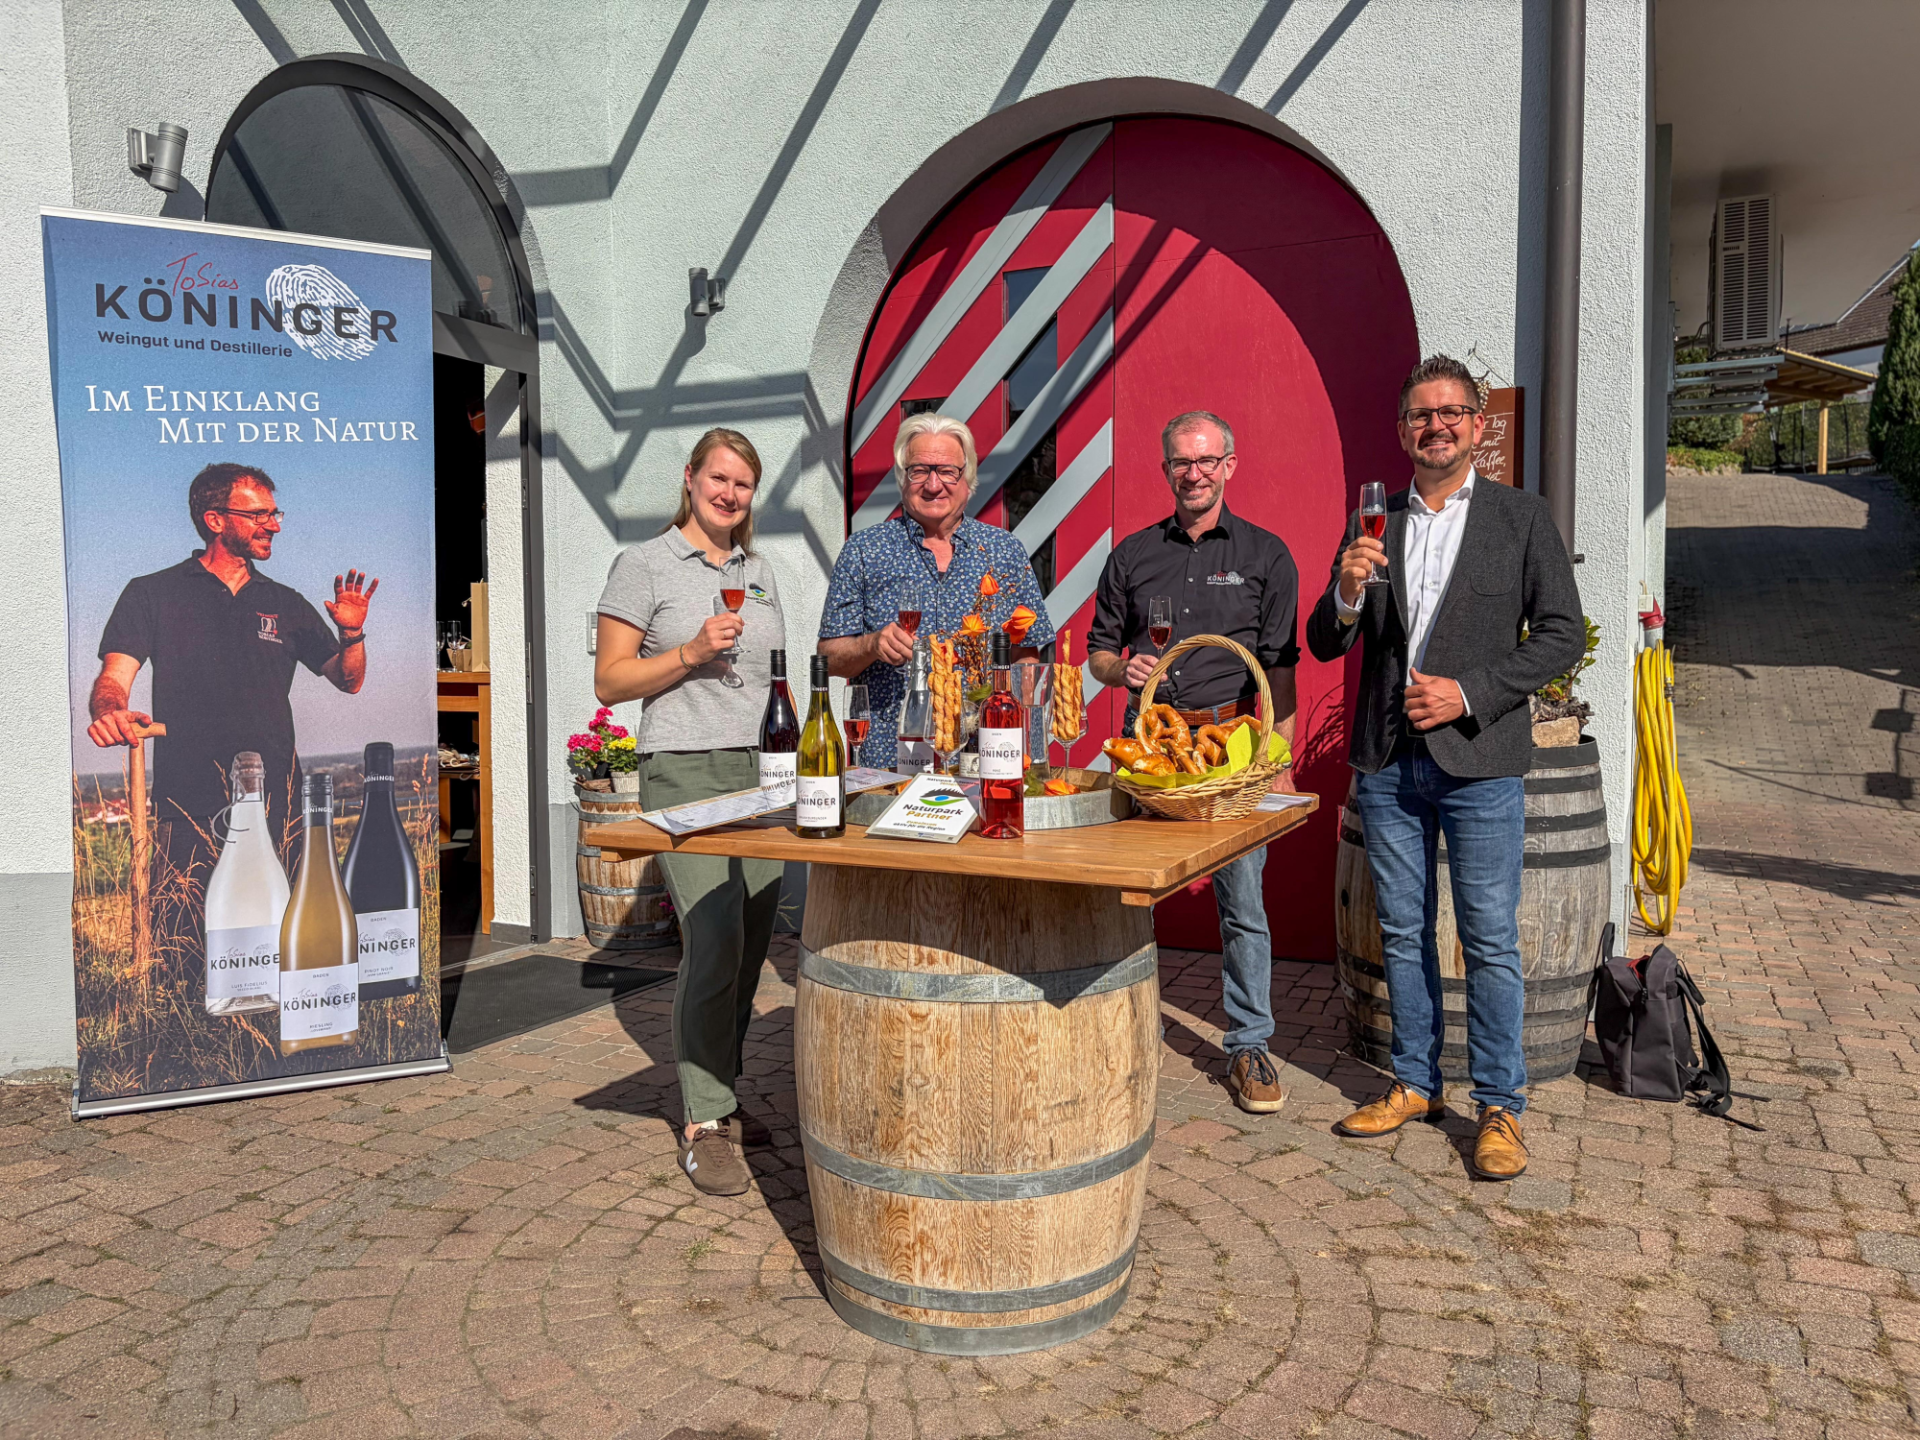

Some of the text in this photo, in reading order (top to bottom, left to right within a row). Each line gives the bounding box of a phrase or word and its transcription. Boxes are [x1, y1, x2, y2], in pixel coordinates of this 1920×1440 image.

[95, 277, 399, 343] KÖNINGER
[98, 330, 293, 357] Weingut und Destillerie
[903, 804, 963, 815] Naturpark
[906, 811, 953, 820] Partner
[360, 938, 416, 954] NINGER
[210, 953, 280, 970] KÖNINGE
[283, 992, 356, 1012] KÖNINGER
